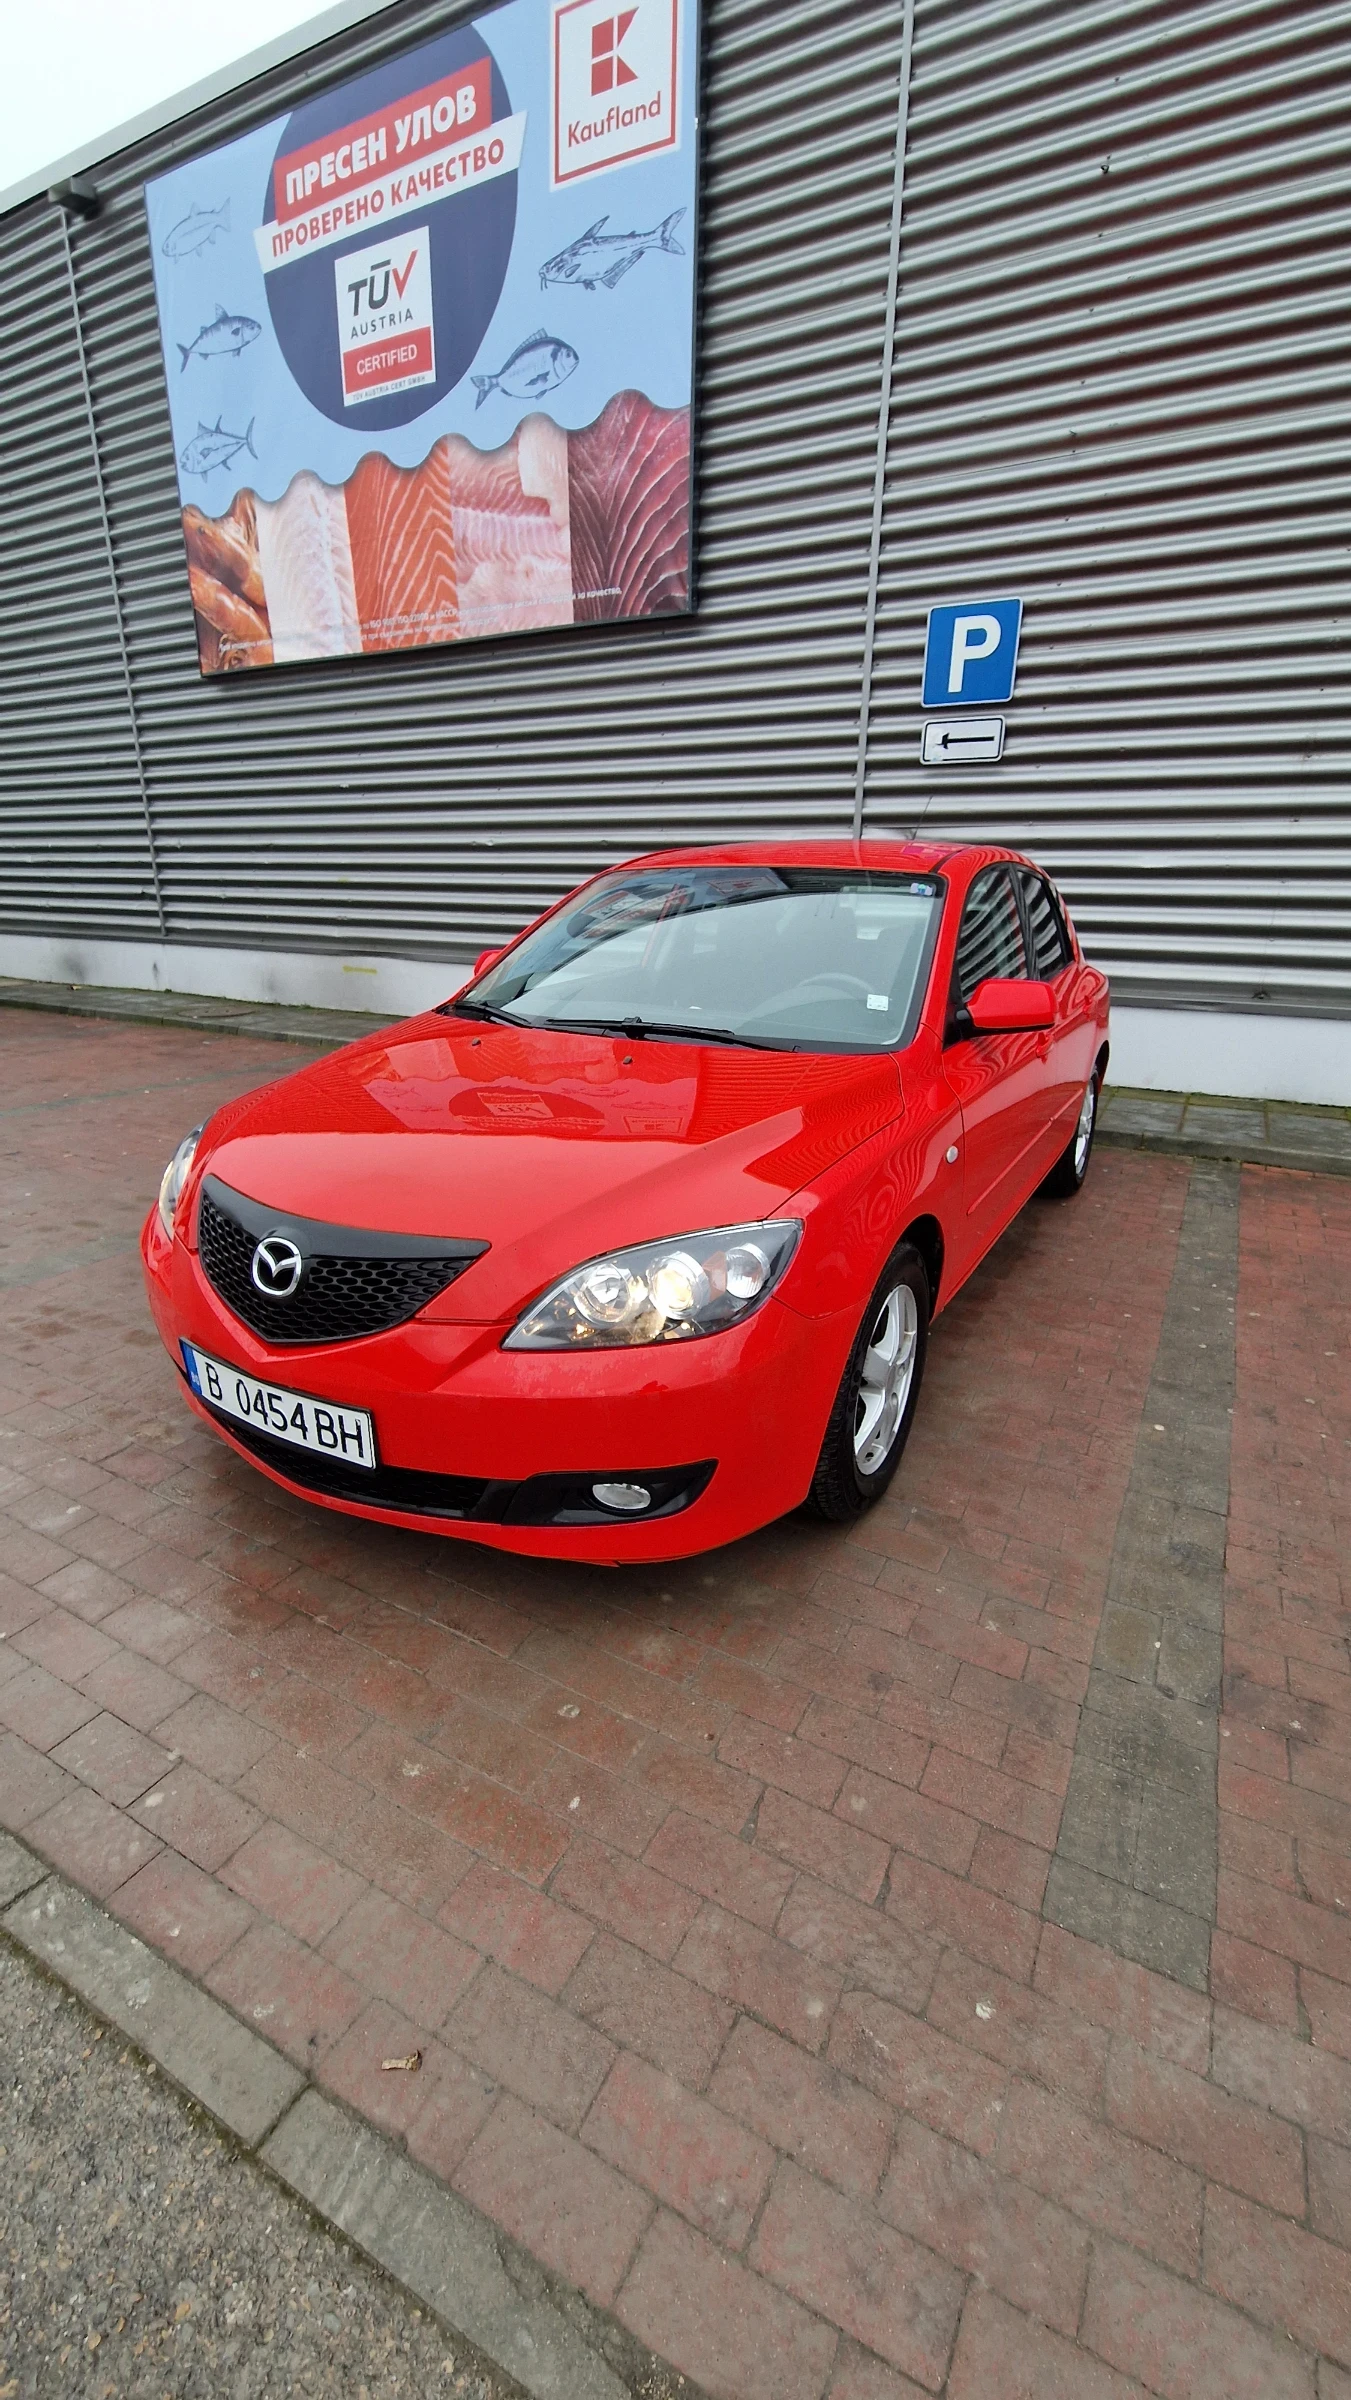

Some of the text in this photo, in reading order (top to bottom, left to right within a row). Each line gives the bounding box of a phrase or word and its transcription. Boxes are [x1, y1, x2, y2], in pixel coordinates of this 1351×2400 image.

[285, 84, 477, 206] ПРЕСЕН УЛОВ
[567, 90, 662, 148] Kaufland
[271, 138, 505, 258] ПРОВЕРЕНО КАЧЕСТВО
[350, 307, 414, 340] AUSTRIA
[356, 343, 418, 376] CERTIFIED
[947, 614, 1002, 693] P
[204, 1361, 223, 1402] B
